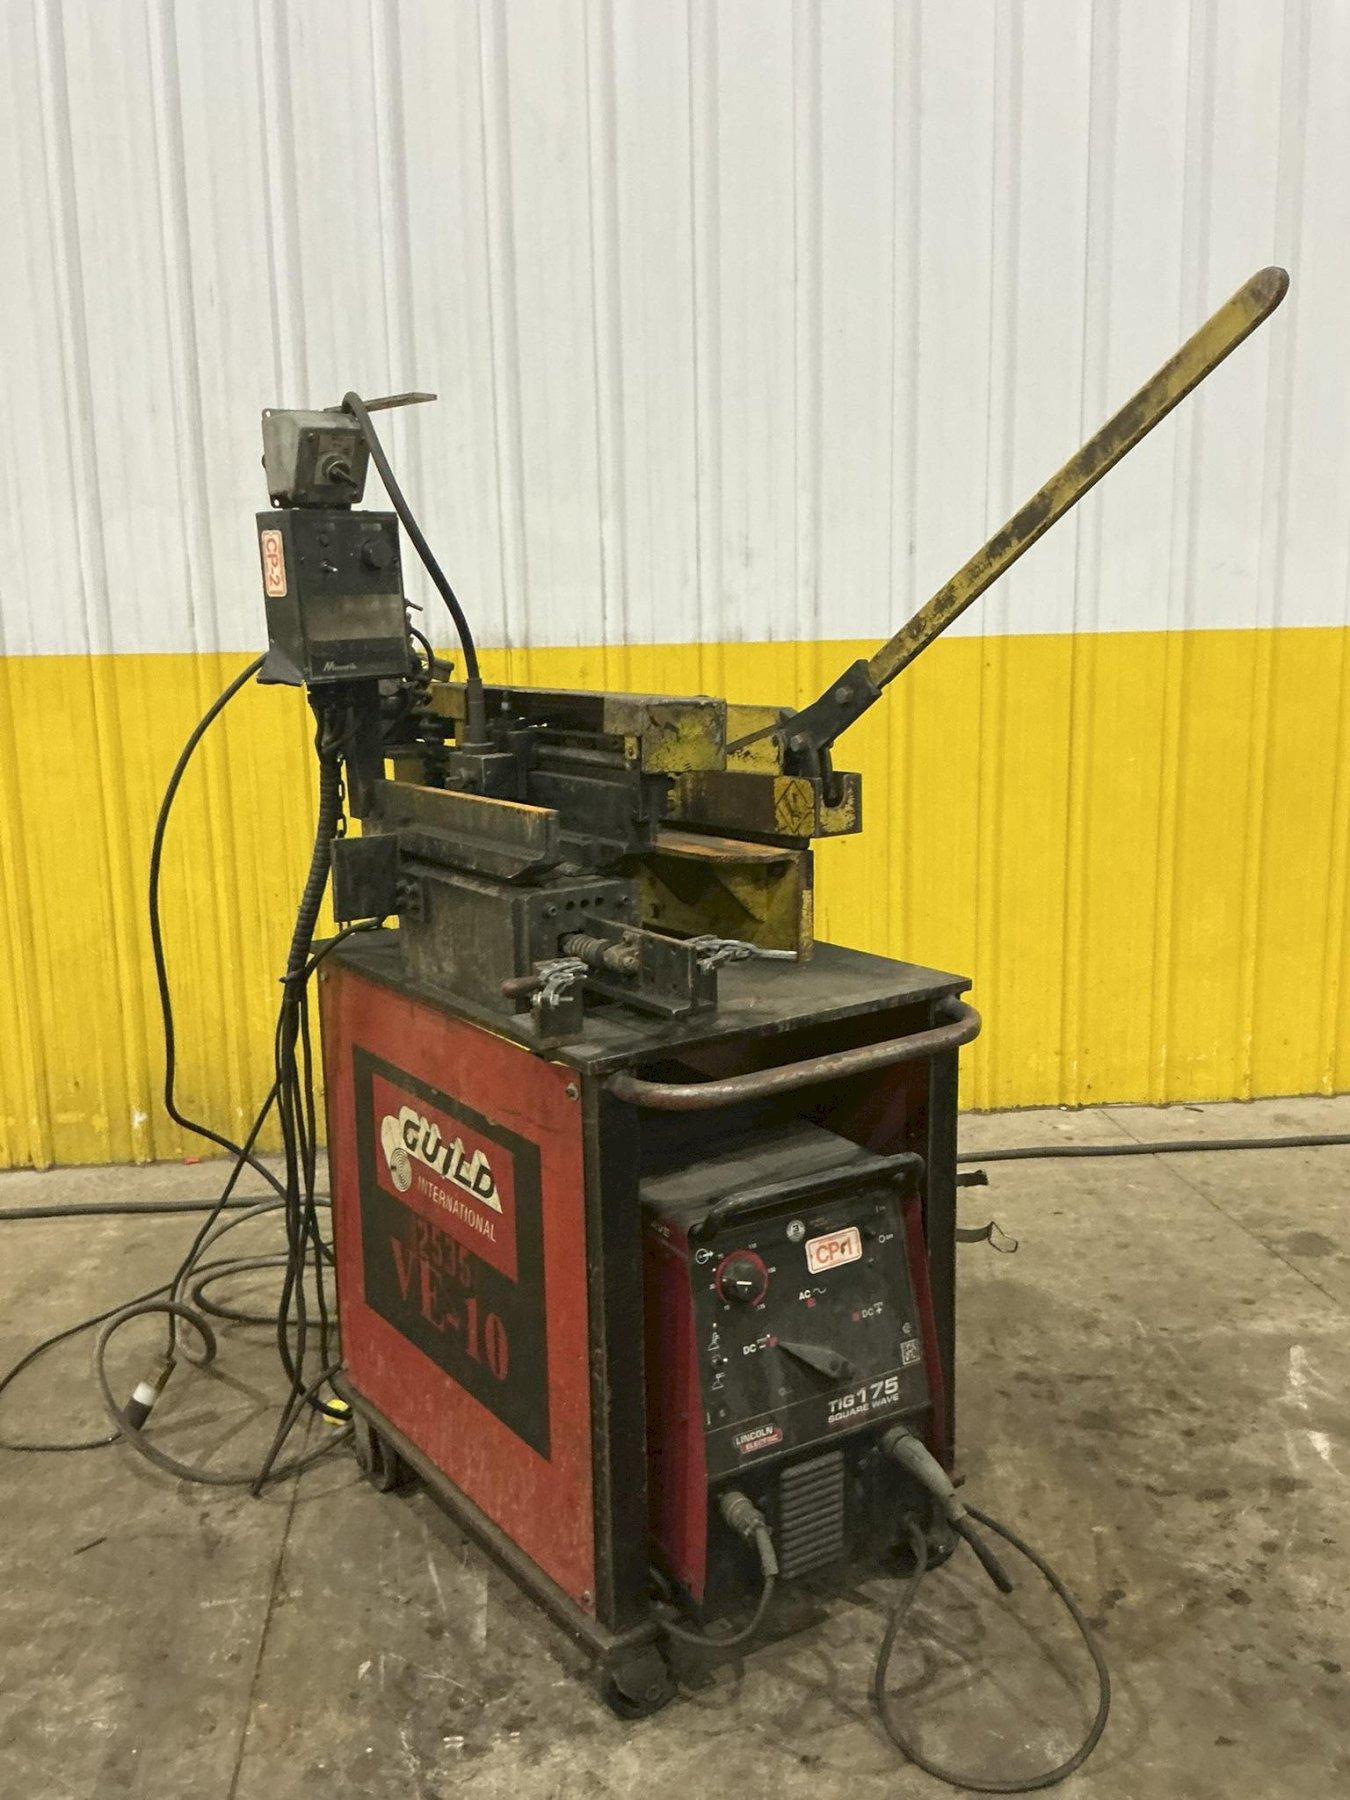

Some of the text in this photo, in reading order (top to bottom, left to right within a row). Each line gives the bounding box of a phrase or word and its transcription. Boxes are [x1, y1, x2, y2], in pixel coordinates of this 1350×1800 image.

[266, 538, 280, 586] CP-2
[401, 1111, 498, 1201] GUILD
[417, 1175, 497, 1243] INTERNATIONAL
[390, 1235, 509, 1381] VE-10
[798, 1289, 812, 1301] AC
[742, 1343, 757, 1356] DC
[828, 1393, 900, 1424] SQUARE WAVE
[735, 1425, 773, 1446] LINCOLN
